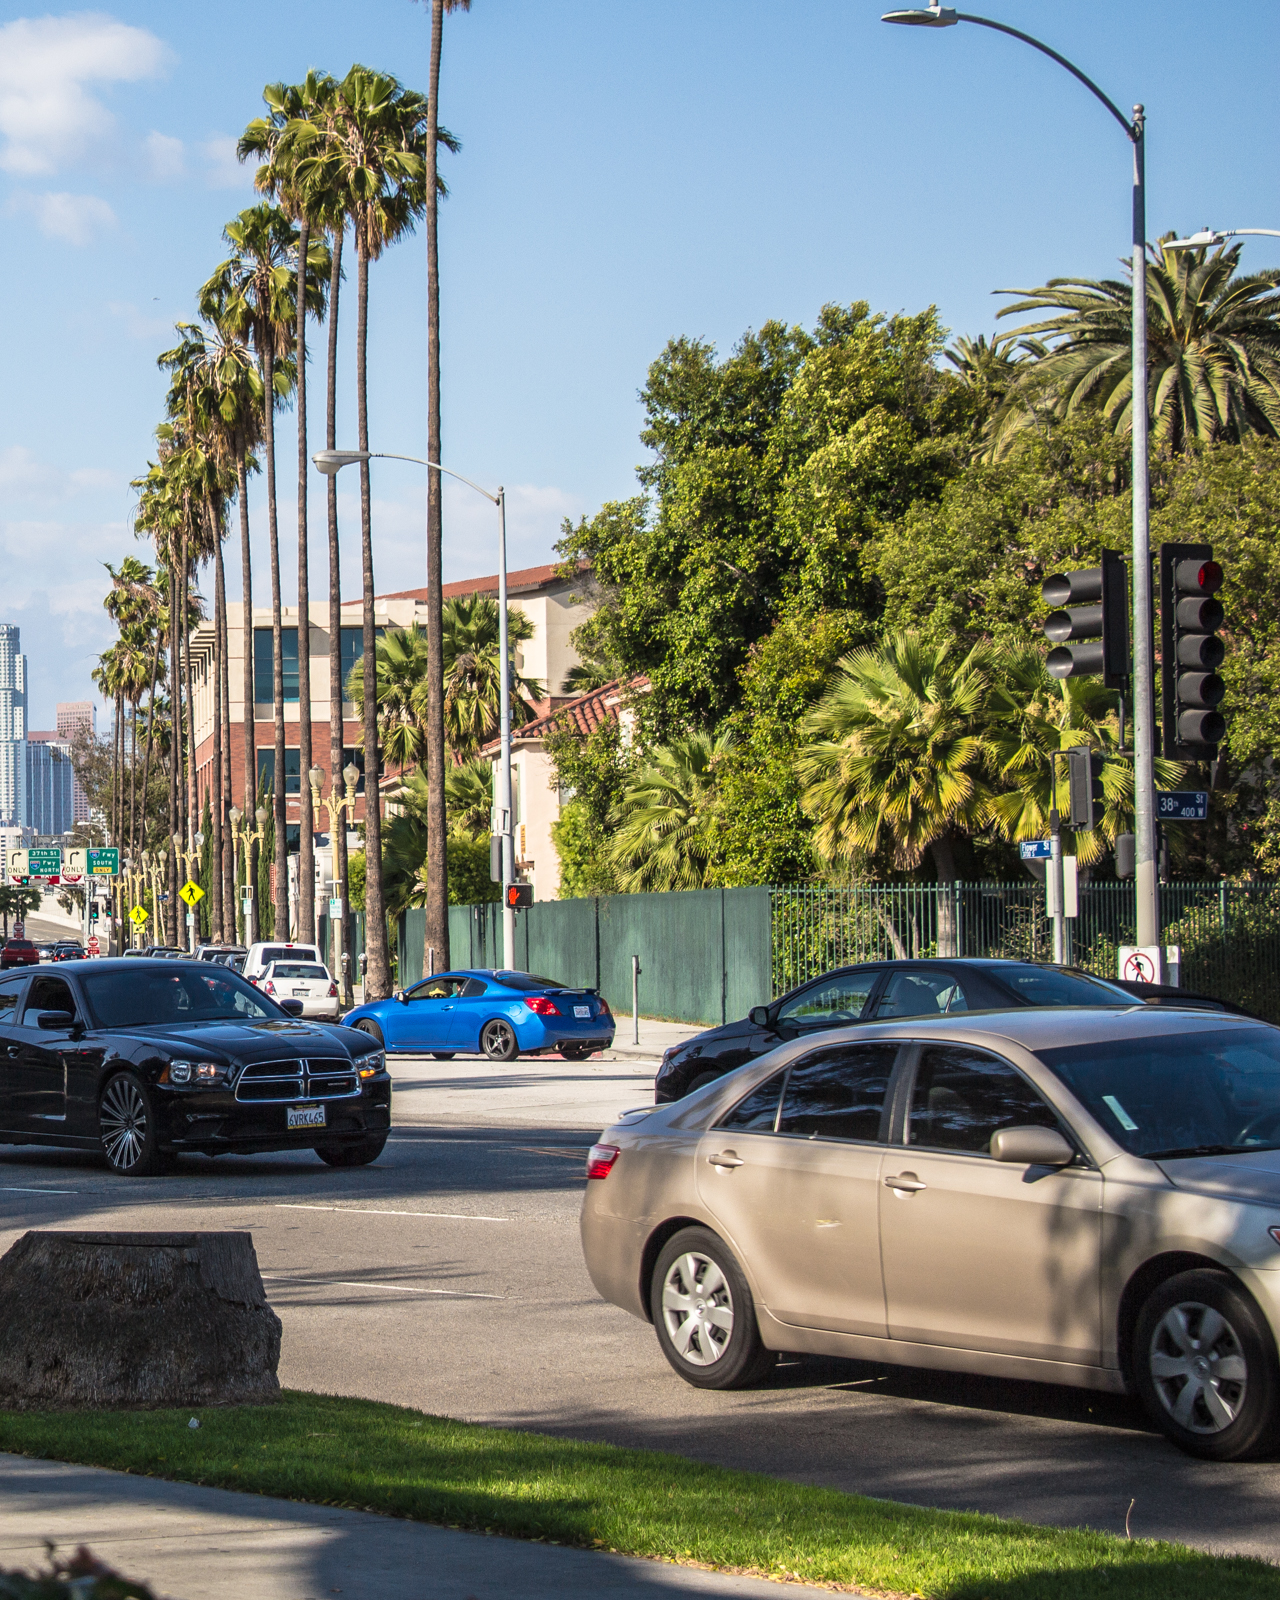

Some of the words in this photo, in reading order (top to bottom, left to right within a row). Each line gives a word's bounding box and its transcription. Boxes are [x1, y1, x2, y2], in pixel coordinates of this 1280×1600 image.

[1196, 794, 1203, 803] St
[1181, 807, 1195, 817] 400
[1197, 807, 1204, 816] W
[1022, 843, 1038, 852] Flower
[1043, 841, 1050, 851] St
[289, 1112, 324, 1126] 6VRK465
